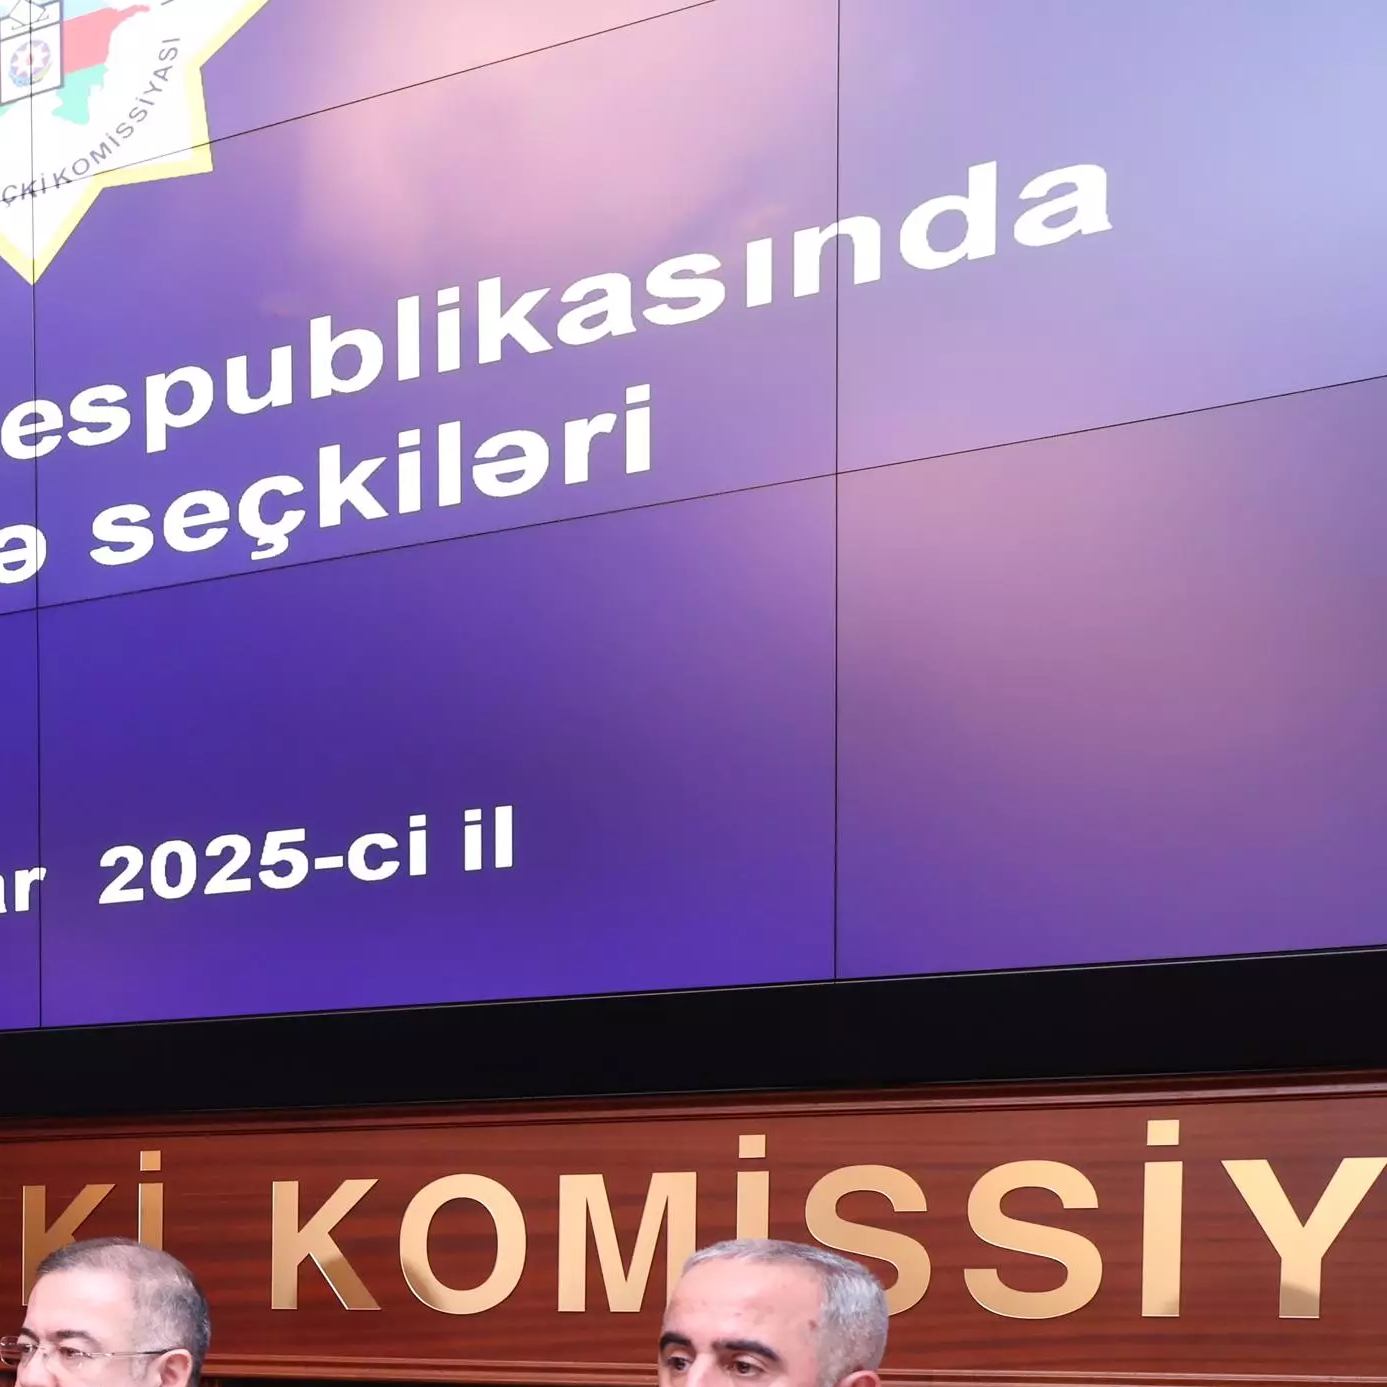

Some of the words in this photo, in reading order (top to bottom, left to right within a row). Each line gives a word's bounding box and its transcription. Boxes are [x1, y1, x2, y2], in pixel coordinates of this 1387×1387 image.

[51, 37, 181, 188] KOMİSSİYASI
[89, 386, 652, 567] seçkiləri
[98, 814, 427, 904] 2025-ci
[464, 805, 514, 872] il
